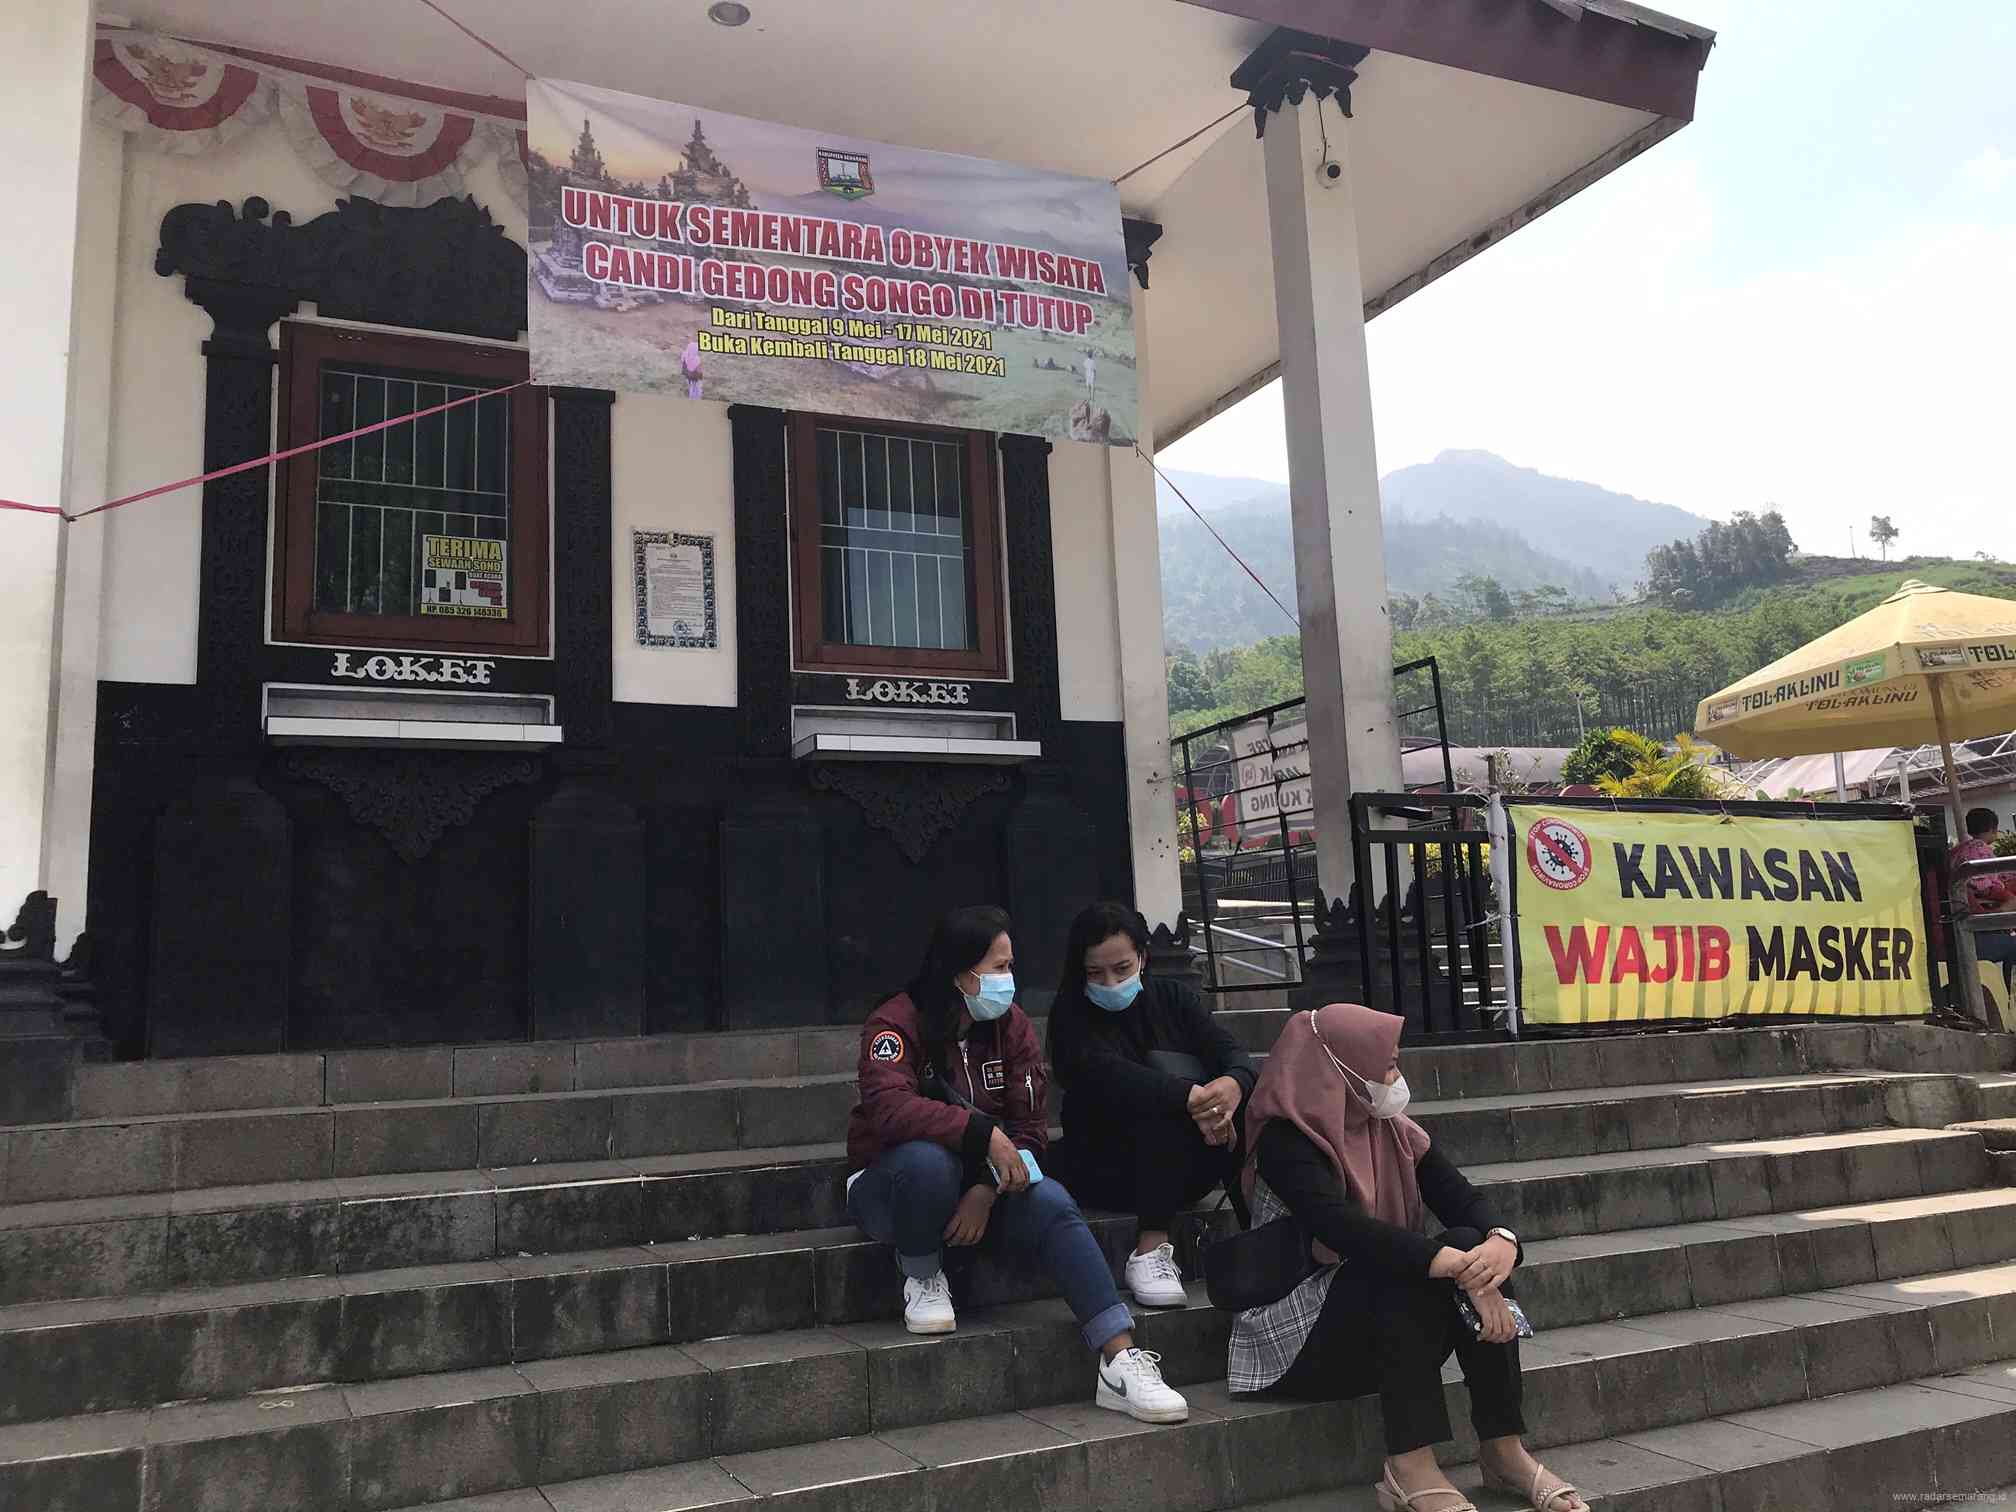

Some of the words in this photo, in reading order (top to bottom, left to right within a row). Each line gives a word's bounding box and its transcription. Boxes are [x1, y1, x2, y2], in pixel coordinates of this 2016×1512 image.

[562, 186, 684, 243] UNTUK
[687, 203, 887, 265] SEMENTARA
[890, 228, 992, 279] OBYEK
[994, 242, 1108, 296] WISATA
[583, 241, 695, 295] CANDI
[700, 259, 838, 311] GEDONG
[842, 272, 956, 320] SONGO
[959, 286, 997, 324] DI
[1000, 290, 1096, 337] TUTUP
[711, 307, 751, 329] Dari
[753, 310, 829, 337] Tanggal
[830, 319, 844, 335] 9
[848, 320, 882, 340] Mei
[895, 322, 912, 342] 17
[915, 325, 950, 345] Mei
[951, 328, 992, 350] 2021
[698, 331, 746, 355] Buka
[748, 336, 827, 360] Kembali
[831, 342, 905, 367] Tanggal
[907, 349, 928, 368] 18
[930, 351, 961, 372] Mei
[963, 355, 1006, 378] 2021
[427, 536, 503, 561] TERIMA
[331, 653, 496, 684] LOKET
[846, 679, 970, 704] LOKET
[1742, 681, 1800, 713] TOLAK
[1800, 670, 1840, 697] LINU
[1613, 843, 1862, 902] KAWASAN
[1544, 925, 1730, 984] WAJIB
[1746, 925, 1914, 981] MASKER
